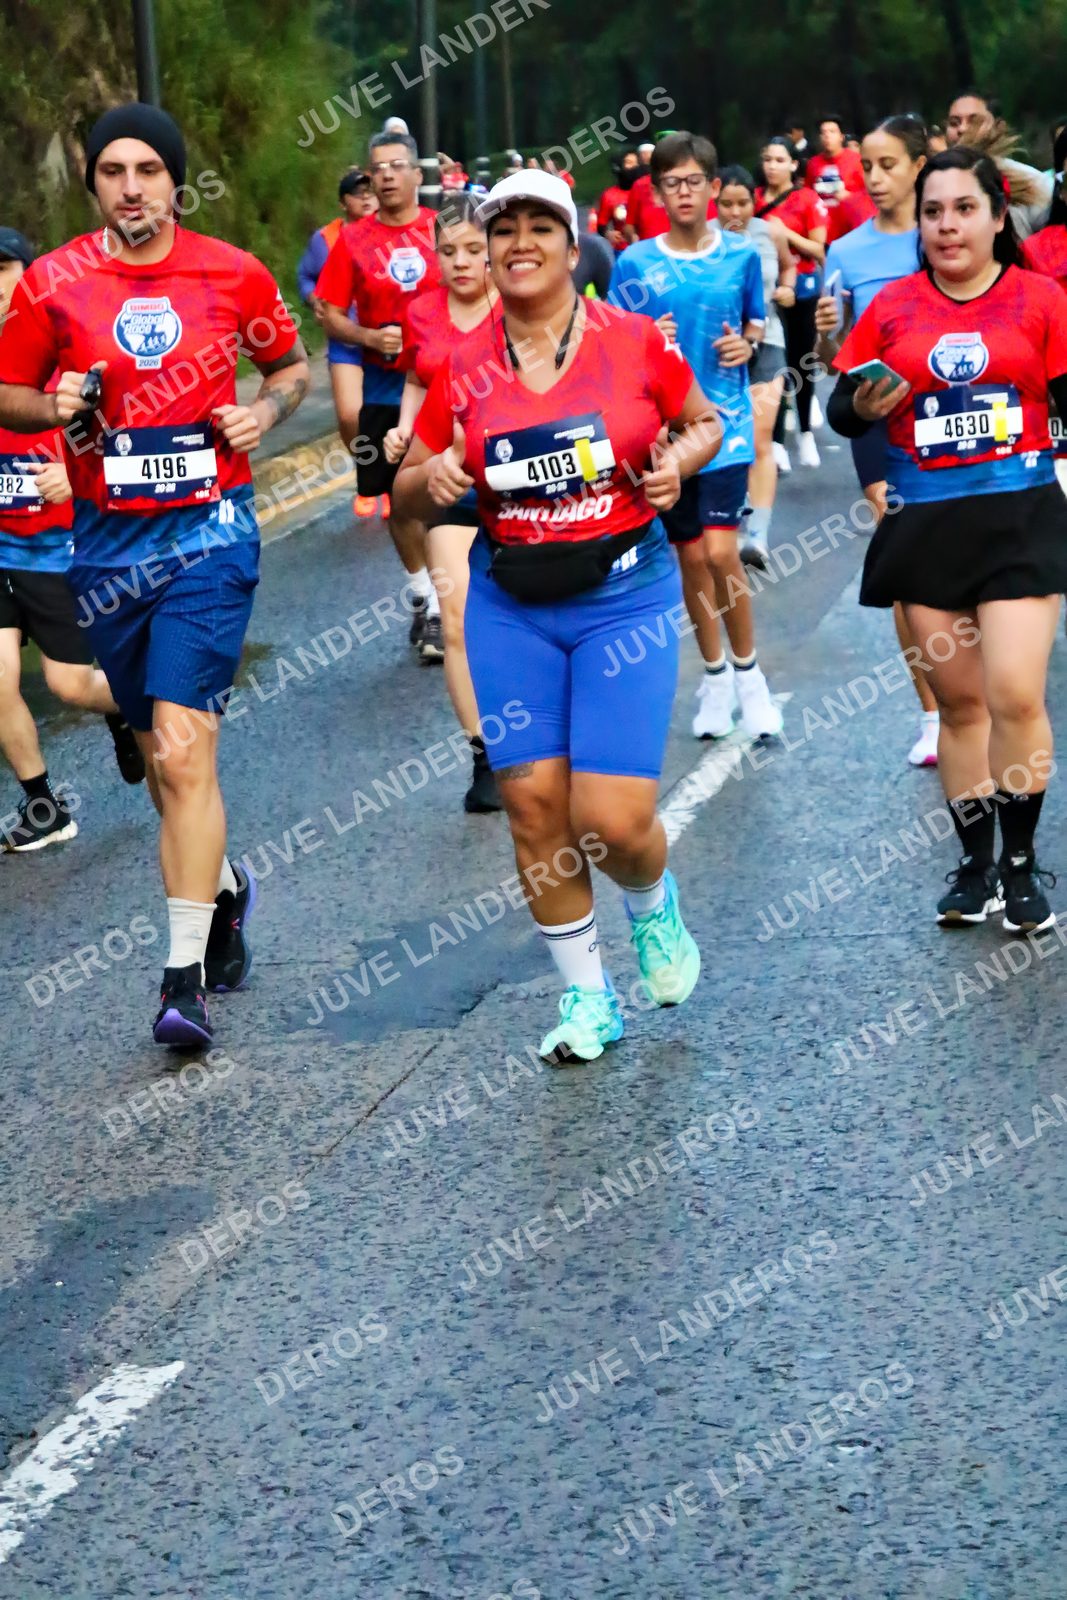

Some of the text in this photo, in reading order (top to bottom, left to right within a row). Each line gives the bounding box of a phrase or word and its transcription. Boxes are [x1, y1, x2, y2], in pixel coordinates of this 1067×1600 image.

[138, 359, 159, 367] 2026
[945, 413, 989, 438] 4630
[141, 456, 187, 479] 4196
[527, 453, 576, 483] 4103
